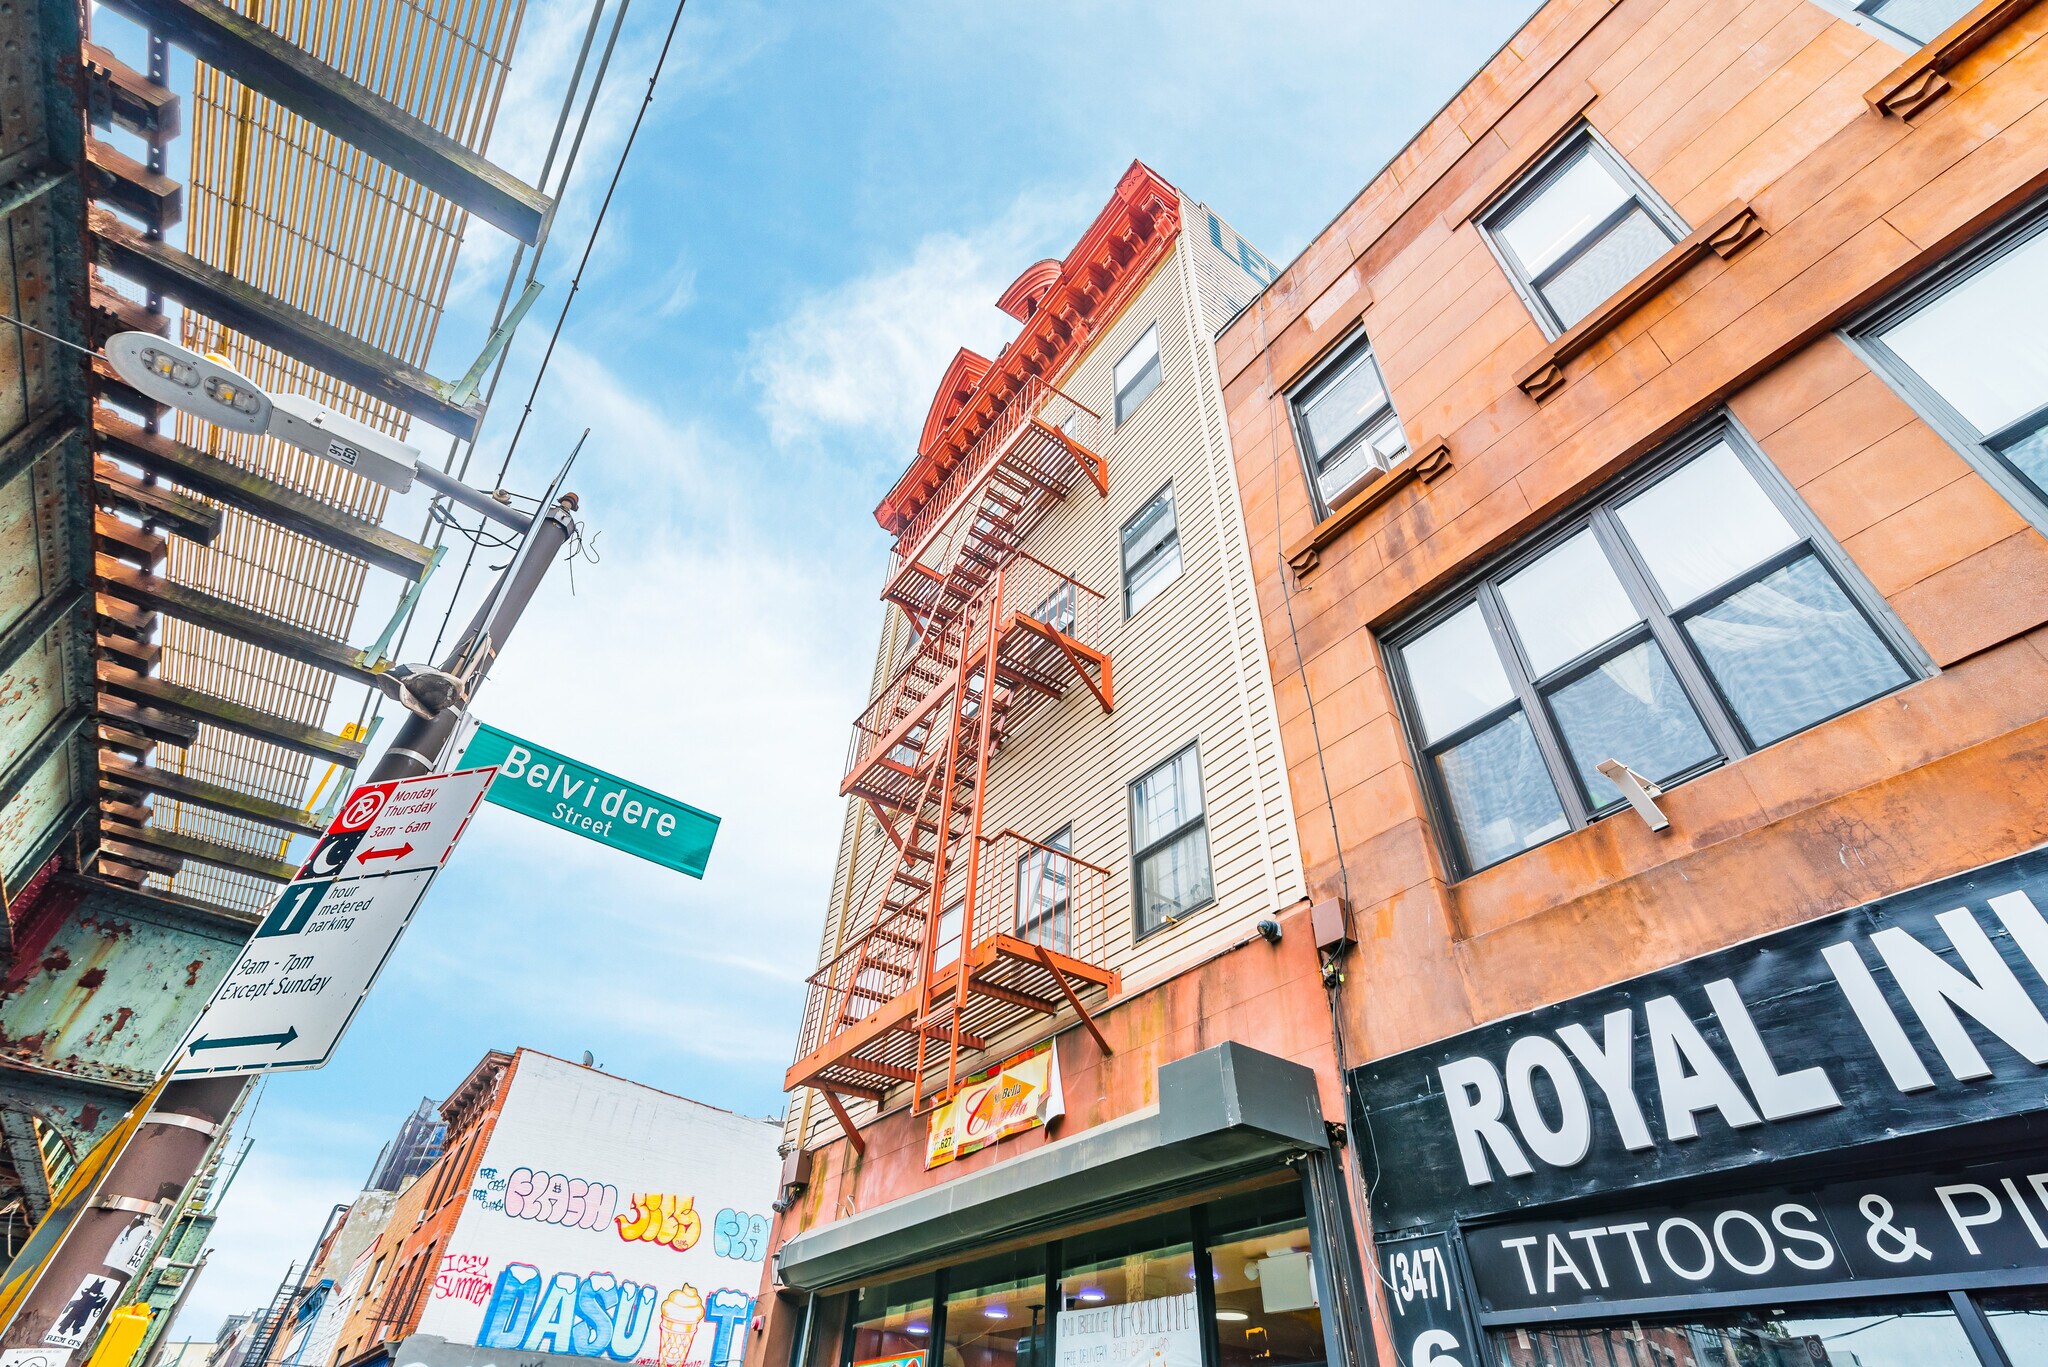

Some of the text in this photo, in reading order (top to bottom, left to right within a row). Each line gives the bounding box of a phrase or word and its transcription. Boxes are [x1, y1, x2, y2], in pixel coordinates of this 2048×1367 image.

[329, 444, 344, 456] 91
[341, 447, 357, 465] LED
[392, 787, 438, 803] Monday
[500, 744, 676, 837] Belvidere
[384, 800, 437, 818] Thursday
[552, 802, 613, 837] Street
[370, 826, 396, 839] 3am
[405, 821, 431, 835] 6am
[329, 885, 359, 900] hour
[279, 887, 315, 932] 1
[318, 897, 375, 917] metered
[304, 915, 355, 936] parking
[237, 958, 270, 976] 9am
[281, 954, 314, 975] 7pm
[220, 974, 332, 1001] Except Sunday
[1002, 1083, 1021, 1100] Bella
[1437, 977, 1843, 1186] ROYAL
[713, 1207, 774, 1263] FLA
[1501, 1202, 1836, 1295] TATTOOS
[1857, 1193, 1933, 1262] &
[1389, 1246, 1452, 1317] (347)
[476, 1261, 658, 1363] DASU
